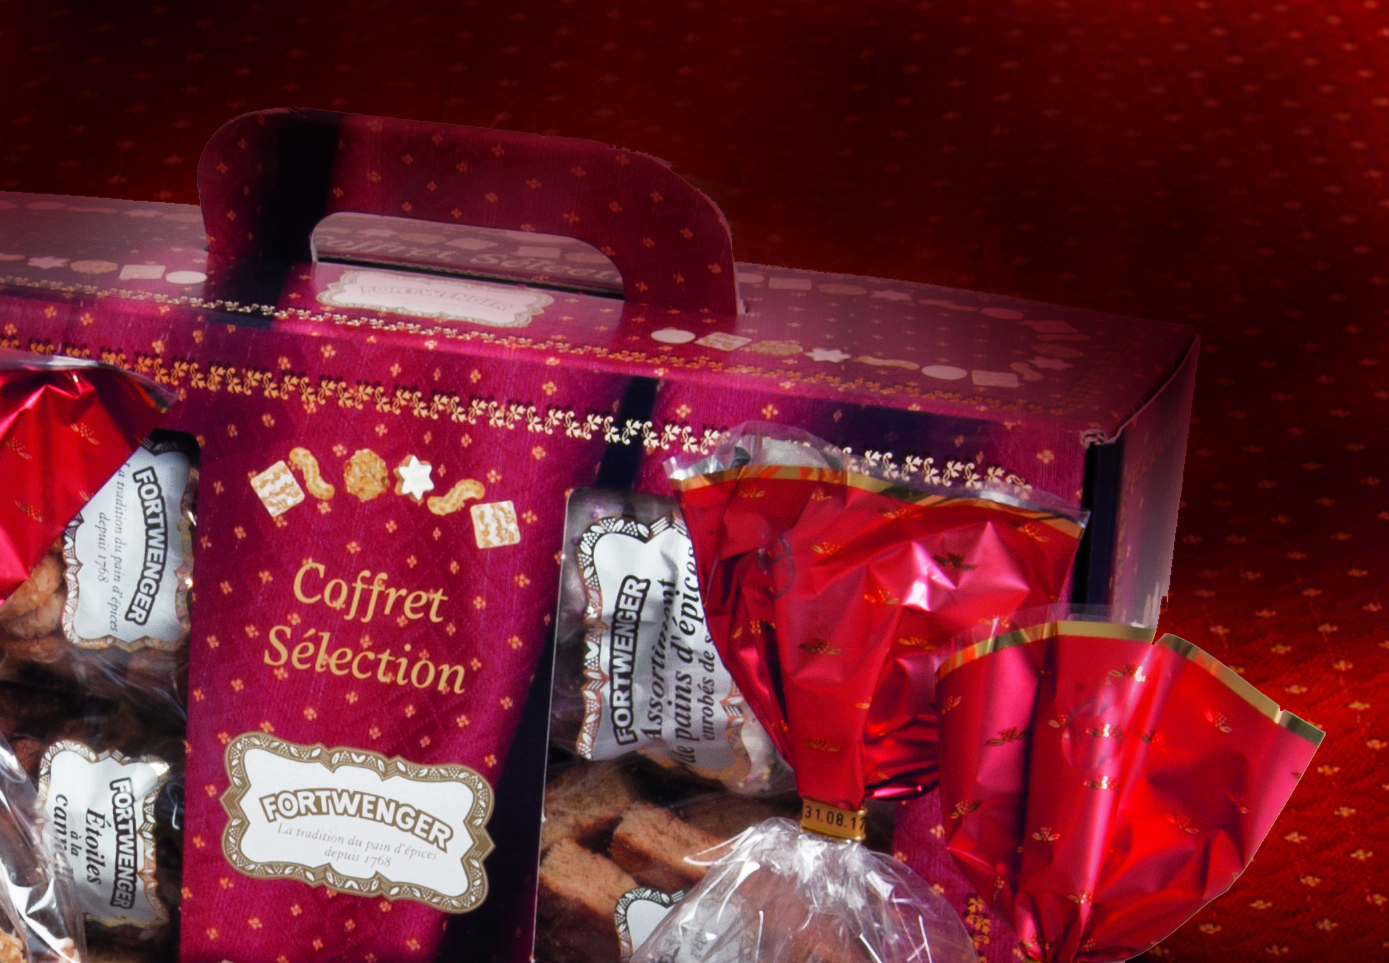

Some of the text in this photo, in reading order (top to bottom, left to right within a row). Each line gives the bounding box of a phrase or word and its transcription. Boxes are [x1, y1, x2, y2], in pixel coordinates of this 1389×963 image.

[113, 481, 125, 534] tradition
[95, 512, 110, 583] depuis 1768
[112, 556, 126, 583] pain
[114, 536, 124, 553] du
[125, 466, 168, 626] FORTWENGER
[107, 586, 124, 632] d'épices
[293, 562, 448, 623] Coffret
[263, 625, 466, 695] Sélection
[611, 574, 651, 746] FORTWENGER
[702, 651, 716, 674] de
[667, 671, 699, 742] pains
[697, 675, 716, 741] enrobés
[681, 745, 697, 764] de
[70, 830, 82, 857] à la
[84, 808, 111, 886] Étoiles
[109, 777, 138, 910] FORTWENGER
[258, 788, 454, 854] FORTWENGER
[277, 822, 438, 861] La tradition du pain d'épices
[324, 846, 392, 869] depuis 1768
